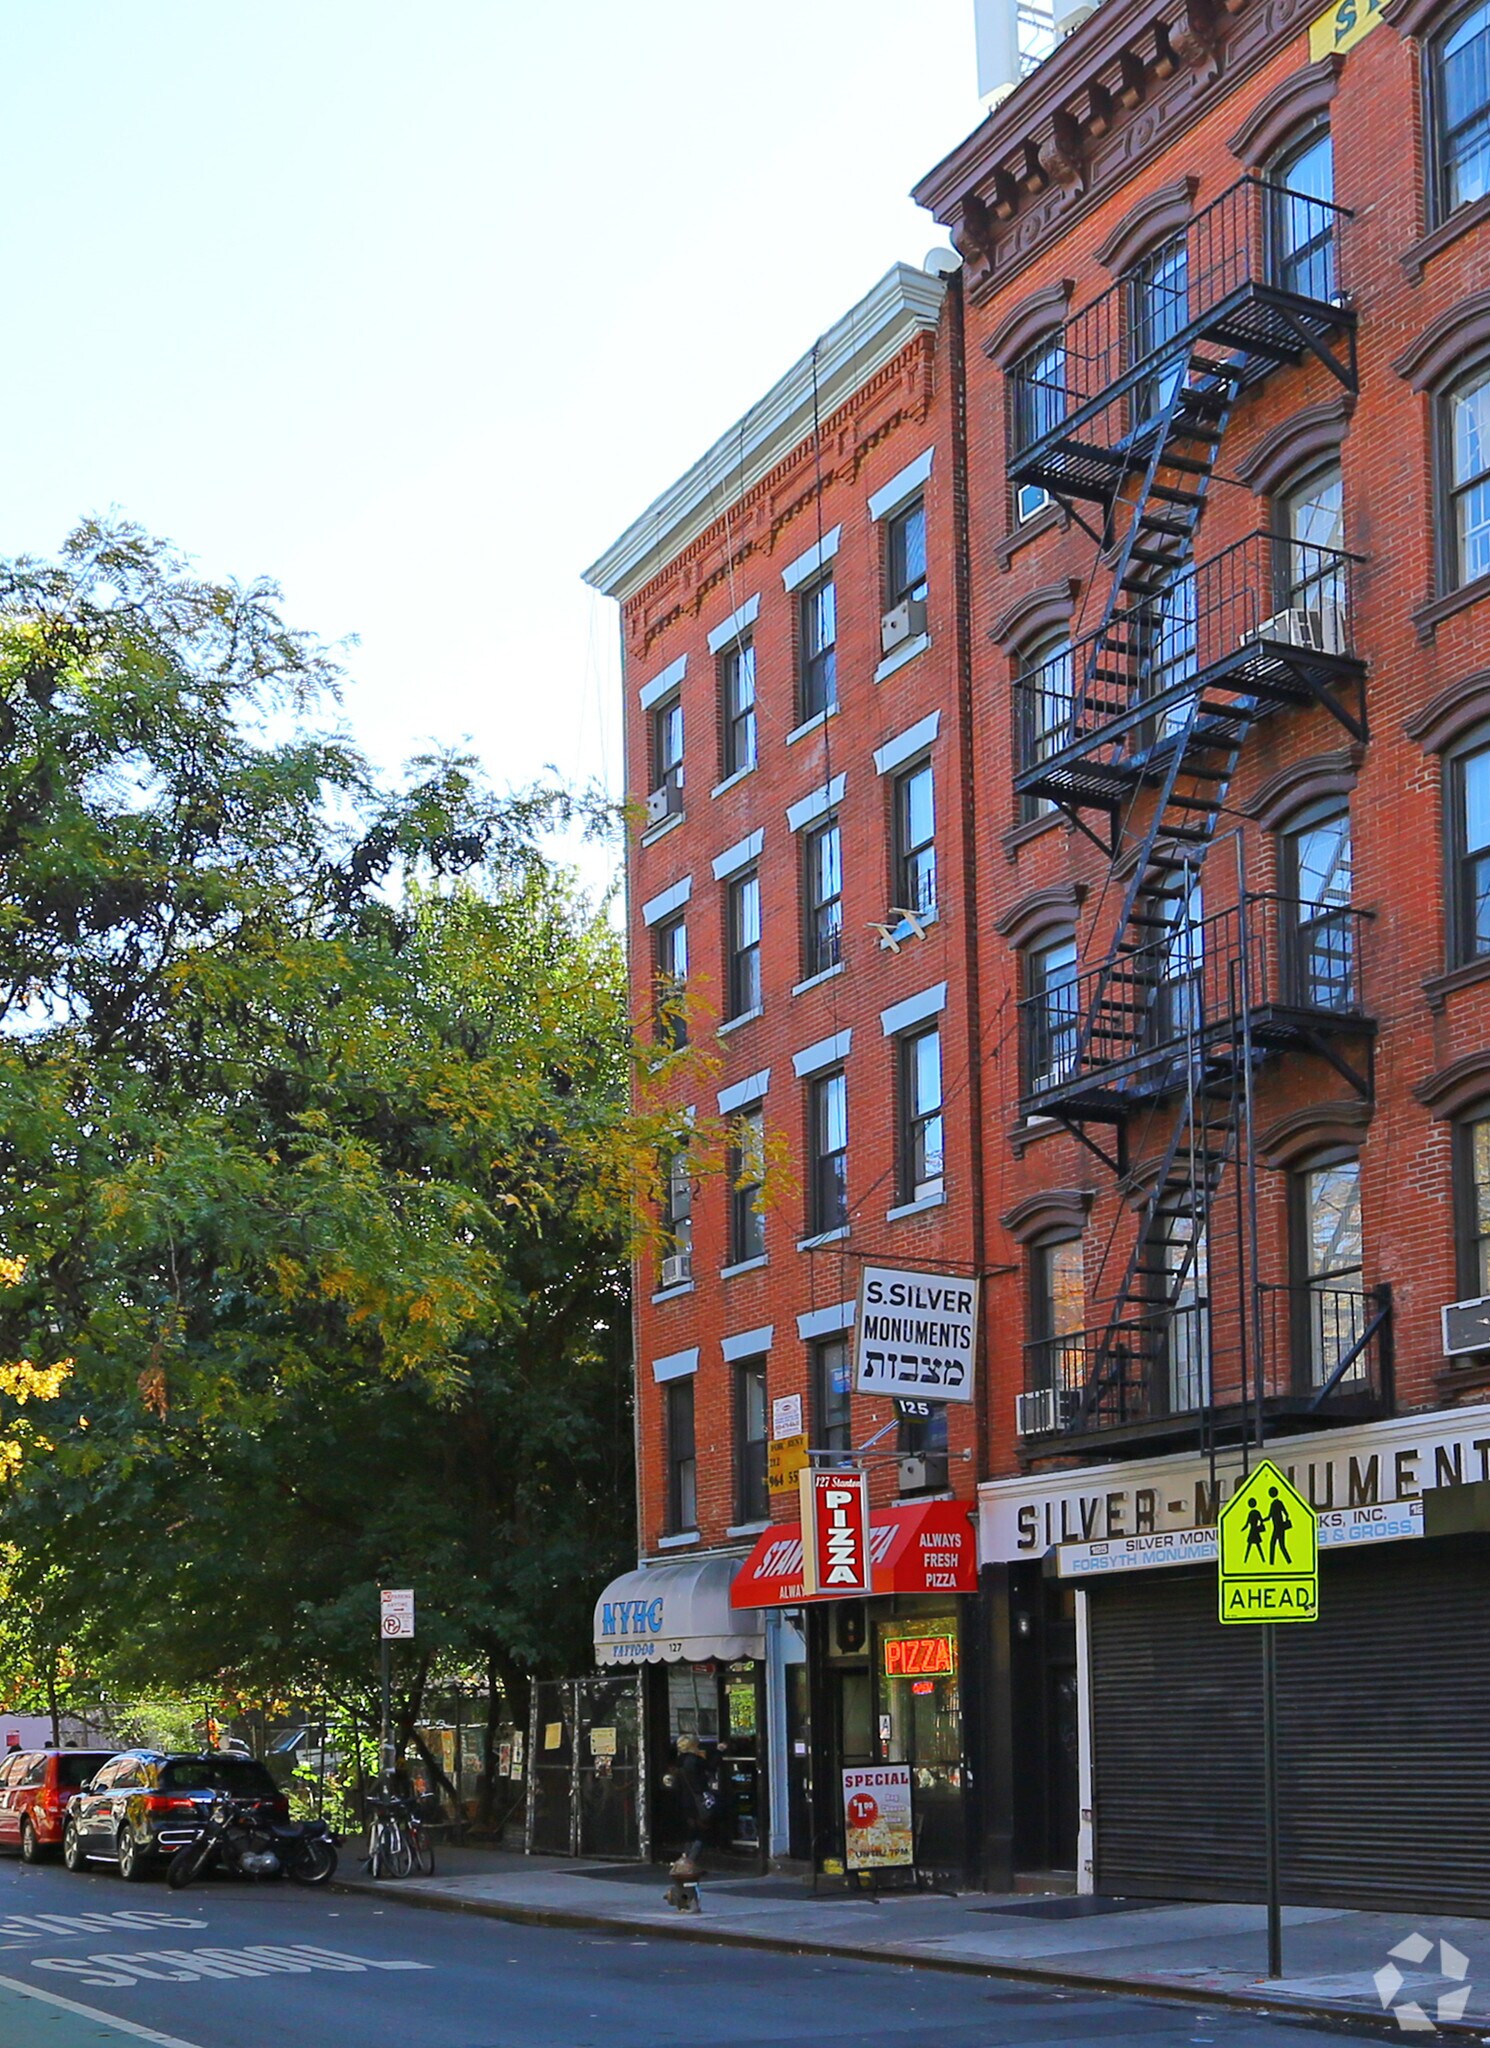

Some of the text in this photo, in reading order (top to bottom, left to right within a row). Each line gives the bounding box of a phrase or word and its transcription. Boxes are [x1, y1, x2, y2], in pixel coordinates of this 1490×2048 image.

[866, 1281, 972, 1314] S.SILVER
[864, 1315, 971, 1349] MONUMENTS
[863, 1350, 965, 1387] מצבות
[899, 1400, 929, 1415] 125
[770, 1438, 804, 1453] FOR RENT
[769, 1457, 780, 1467] 212
[788, 1471, 800, 1484] 55
[815, 1476, 830, 1488] 127
[825, 1490, 859, 1584] PIZZA
[919, 1532, 961, 1548] ALWAYS
[1091, 1545, 1108, 1555] 125
[1125, 1535, 1174, 1552] SILVER
[1179, 1530, 1219, 1546] MON
[1316, 1513, 1346, 1528] KS,
[1353, 1508, 1388, 1524] INC.
[1072, 1554, 1137, 1572] FORSYTH
[1142, 1544, 1219, 1564] MONUMEN
[1332, 1528, 1345, 1542] &
[1349, 1520, 1416, 1540] GROSS,
[753, 1539, 804, 1579] STAN
[923, 1553, 958, 1568] FRESH
[925, 1573, 956, 1588] PIZZA
[779, 1584, 806, 1600] ALWAY
[1230, 1588, 1309, 1609] AHEAD
[602, 1597, 664, 1636] NYHC
[612, 1643, 656, 1658] TATTOOS
[668, 1643, 682, 1652] 127
[887, 1638, 951, 1674] PIZZA
[845, 1772, 909, 1788] SPECIAL
[30, 1944, 435, 1987] SCHOOL
